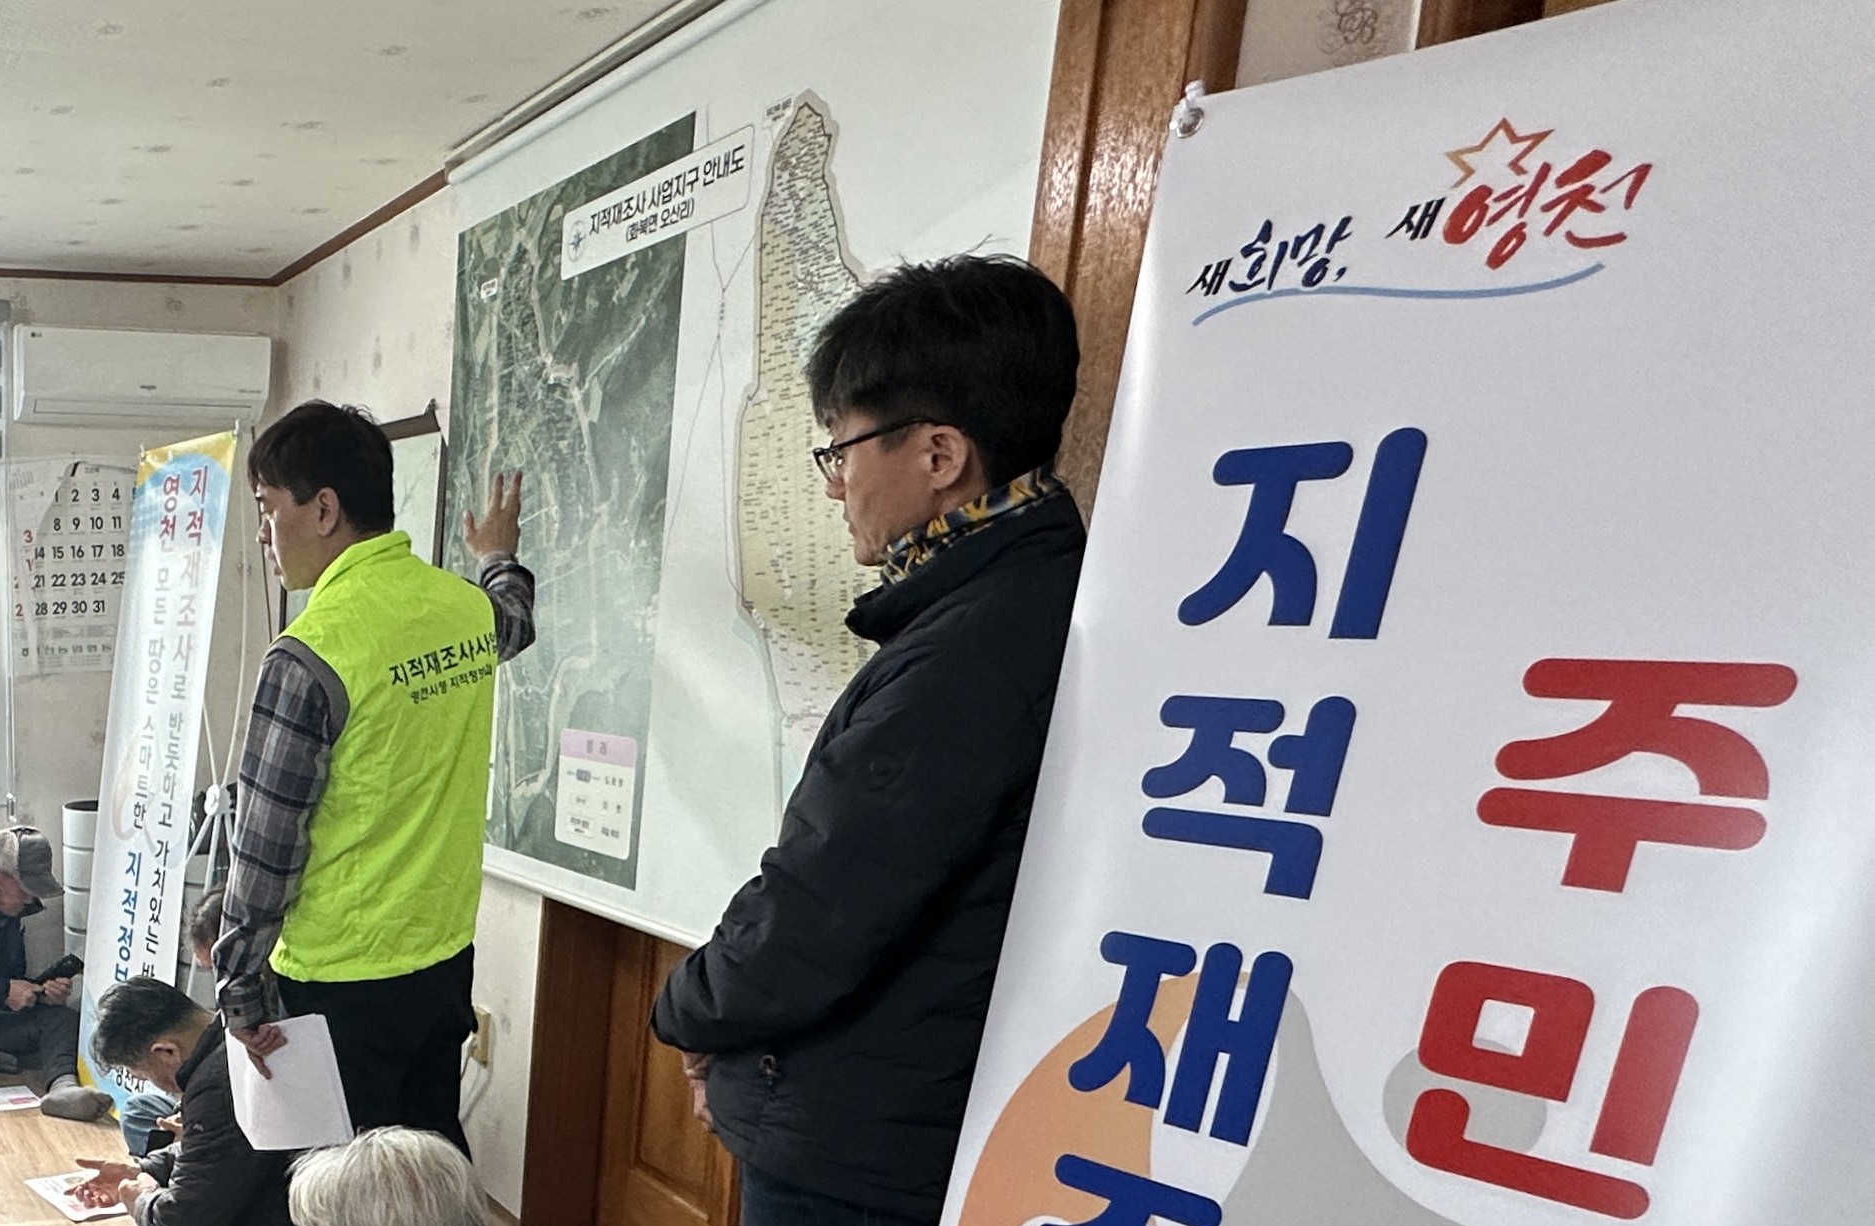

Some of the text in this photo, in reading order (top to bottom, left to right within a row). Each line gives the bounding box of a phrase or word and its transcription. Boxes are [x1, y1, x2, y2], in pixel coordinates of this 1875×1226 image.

[588, 144, 746, 236] 지적재조사 사업지구 안내도
[625, 197, 695, 243] (화북면 오산리)
[53, 515, 122, 531] 8 9 10 11
[71, 488, 80, 503] 2
[91, 488, 100, 502] 3
[111, 487, 120, 501] 4
[158, 473, 182, 554] 영천
[34, 543, 125, 560] 14 15 16 17 18
[34, 574, 45, 588] 21
[51, 573, 66, 587] 22
[70, 573, 86, 587] 23
[90, 572, 106, 586] 24
[110, 571, 125, 585] 25
[35, 599, 105, 616] 28 29 30 31
[153, 567, 172, 627] 모든
[145, 637, 166, 706] 땅은
[132, 719, 157, 830] 스마트한
[156, 712, 185, 829] 반듯하고
[144, 839, 170, 955] 가치있는
